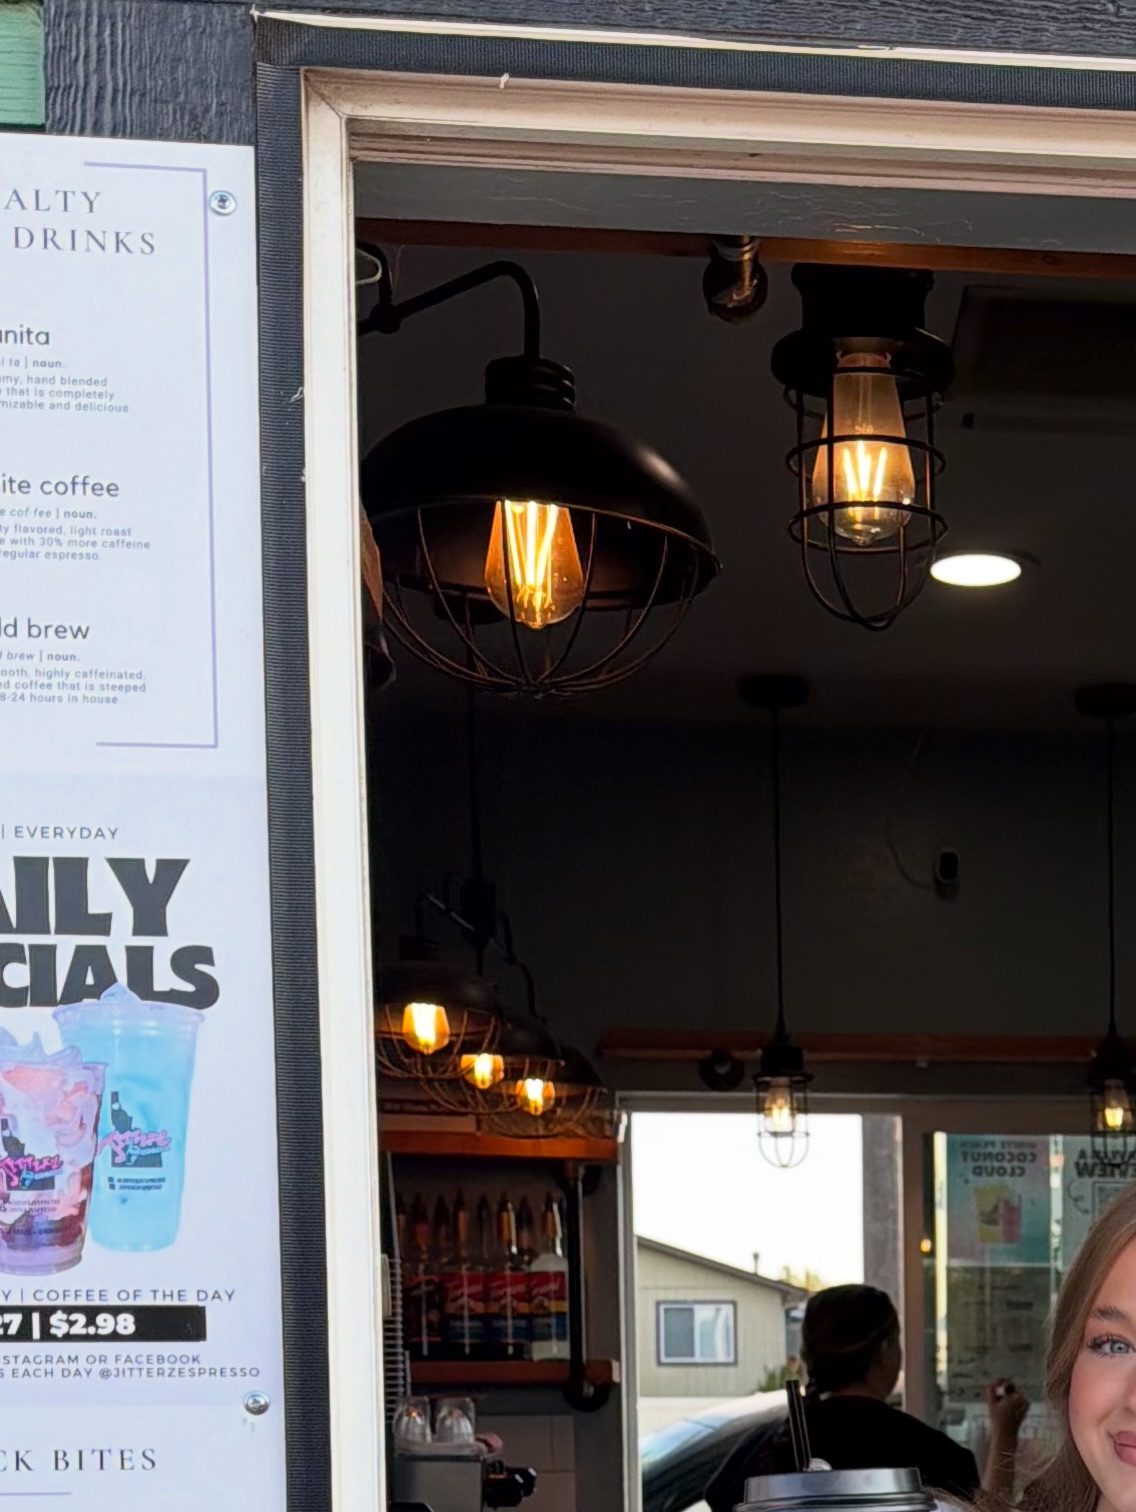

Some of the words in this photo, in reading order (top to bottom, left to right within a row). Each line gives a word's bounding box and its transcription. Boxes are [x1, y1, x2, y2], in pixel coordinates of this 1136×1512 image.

[13, 226, 156, 255] DRINKS
[40, 475, 120, 497] coffee
[27, 617, 90, 639] brew
[35, 668, 70, 680] highly
[75, 669, 146, 681] caffeinated,
[14, 825, 119, 840] EVERYDAY
[32, 1289, 109, 1301] COFFEE
[117, 1289, 140, 1301] OF
[150, 1289, 187, 1301] THE
[196, 1289, 236, 1301] DAY
[49, 1310, 136, 1337] $2.98
[86, 1355, 108, 1365] OR
[115, 1354, 201, 1365] FACEBOOK
[11, 1367, 54, 1378] EACH
[61, 1367, 93, 1378] DAY
[99, 1366, 261, 1379] @JITTERZESPRESSO
[53, 1448, 156, 1471] BITES
